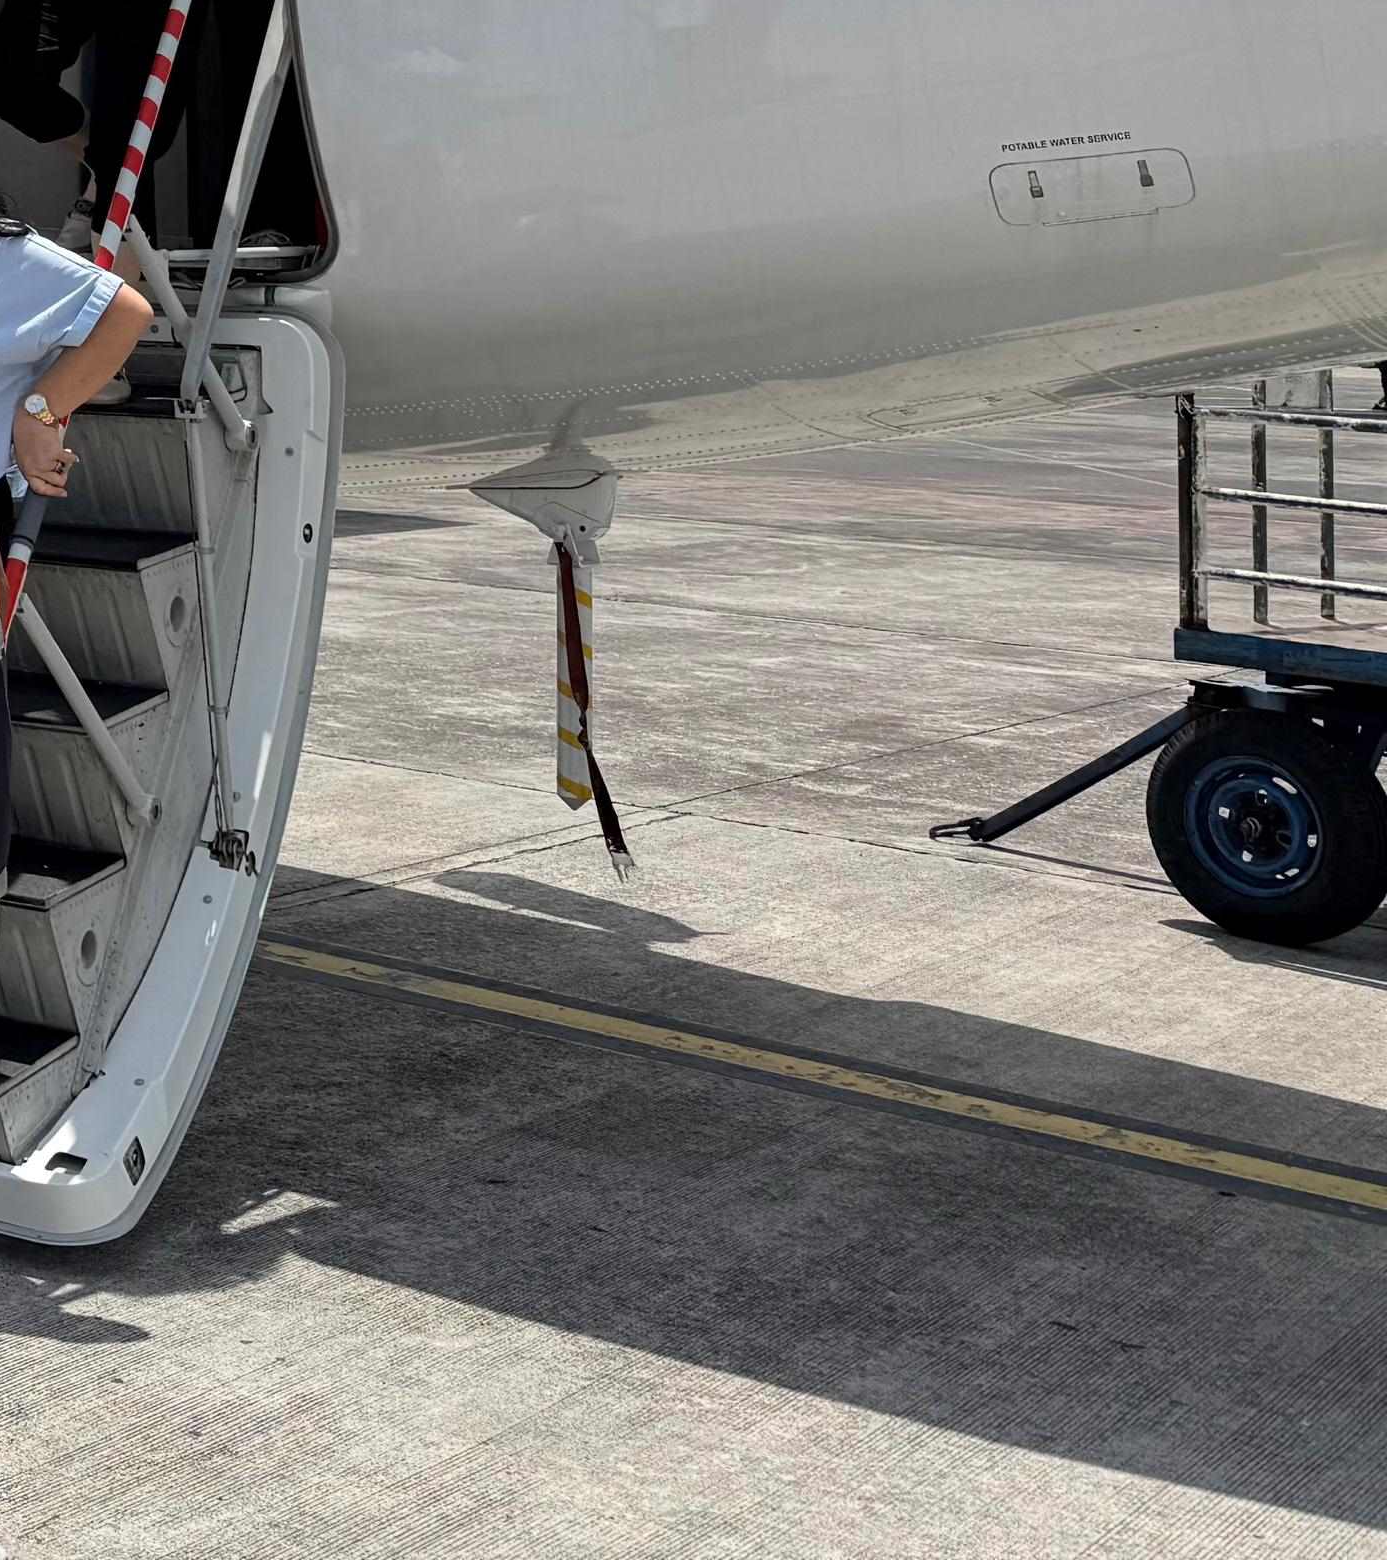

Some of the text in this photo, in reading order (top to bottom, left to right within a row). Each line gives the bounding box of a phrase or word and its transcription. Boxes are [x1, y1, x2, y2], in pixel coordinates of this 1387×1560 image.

[1001, 131, 1131, 153] POTABLE WATER SERVICE
